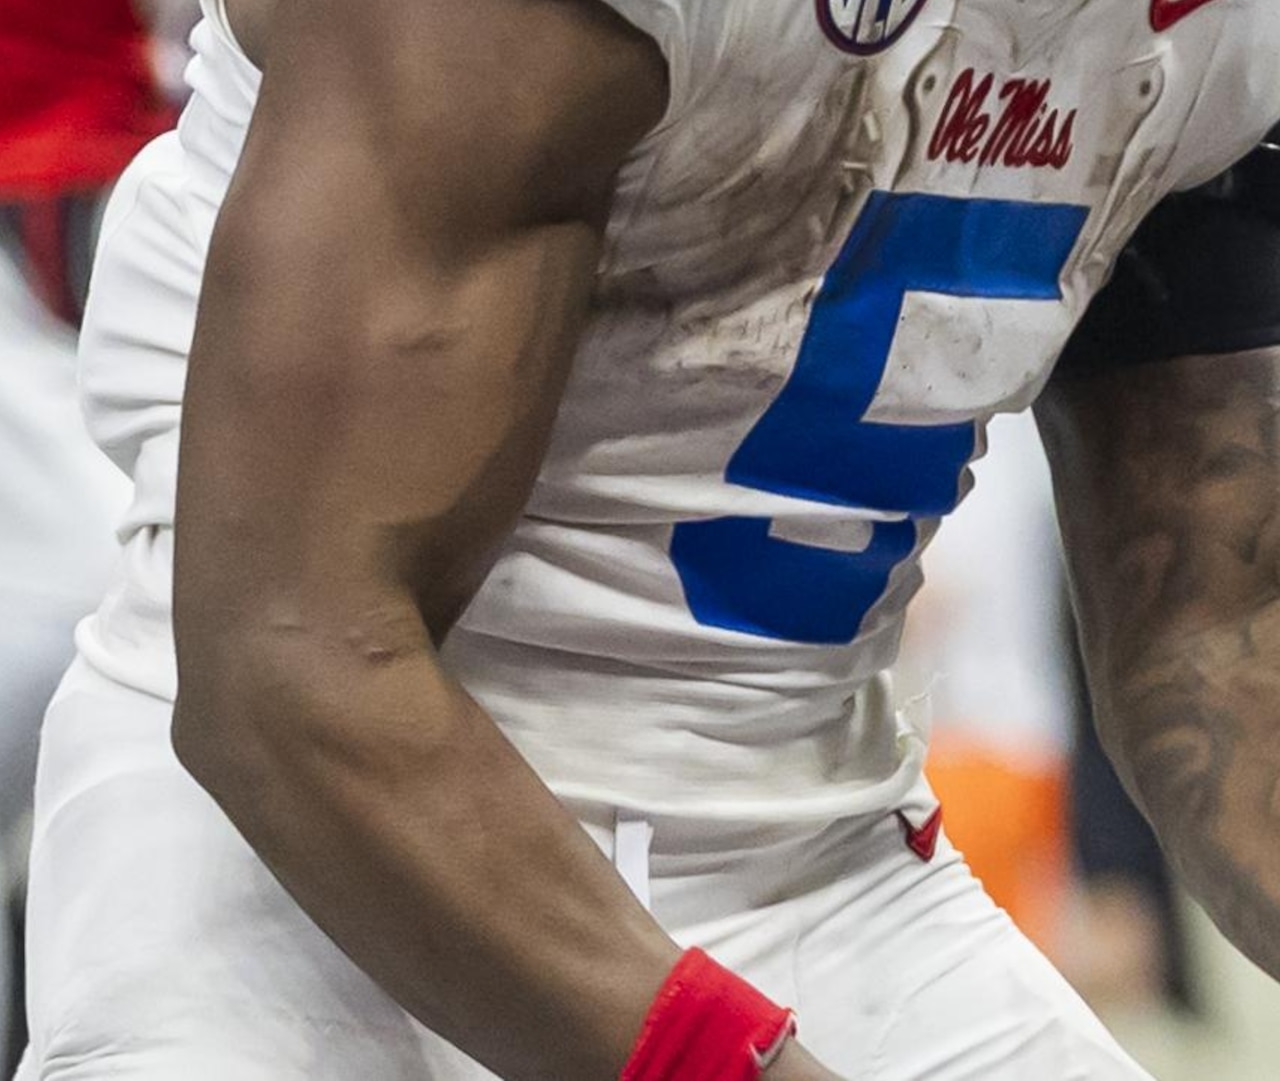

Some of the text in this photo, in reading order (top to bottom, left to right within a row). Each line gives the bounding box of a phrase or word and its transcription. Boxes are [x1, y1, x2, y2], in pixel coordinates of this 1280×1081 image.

[927, 67, 1077, 170] Ole Miss
[669, 188, 1091, 646] 5
